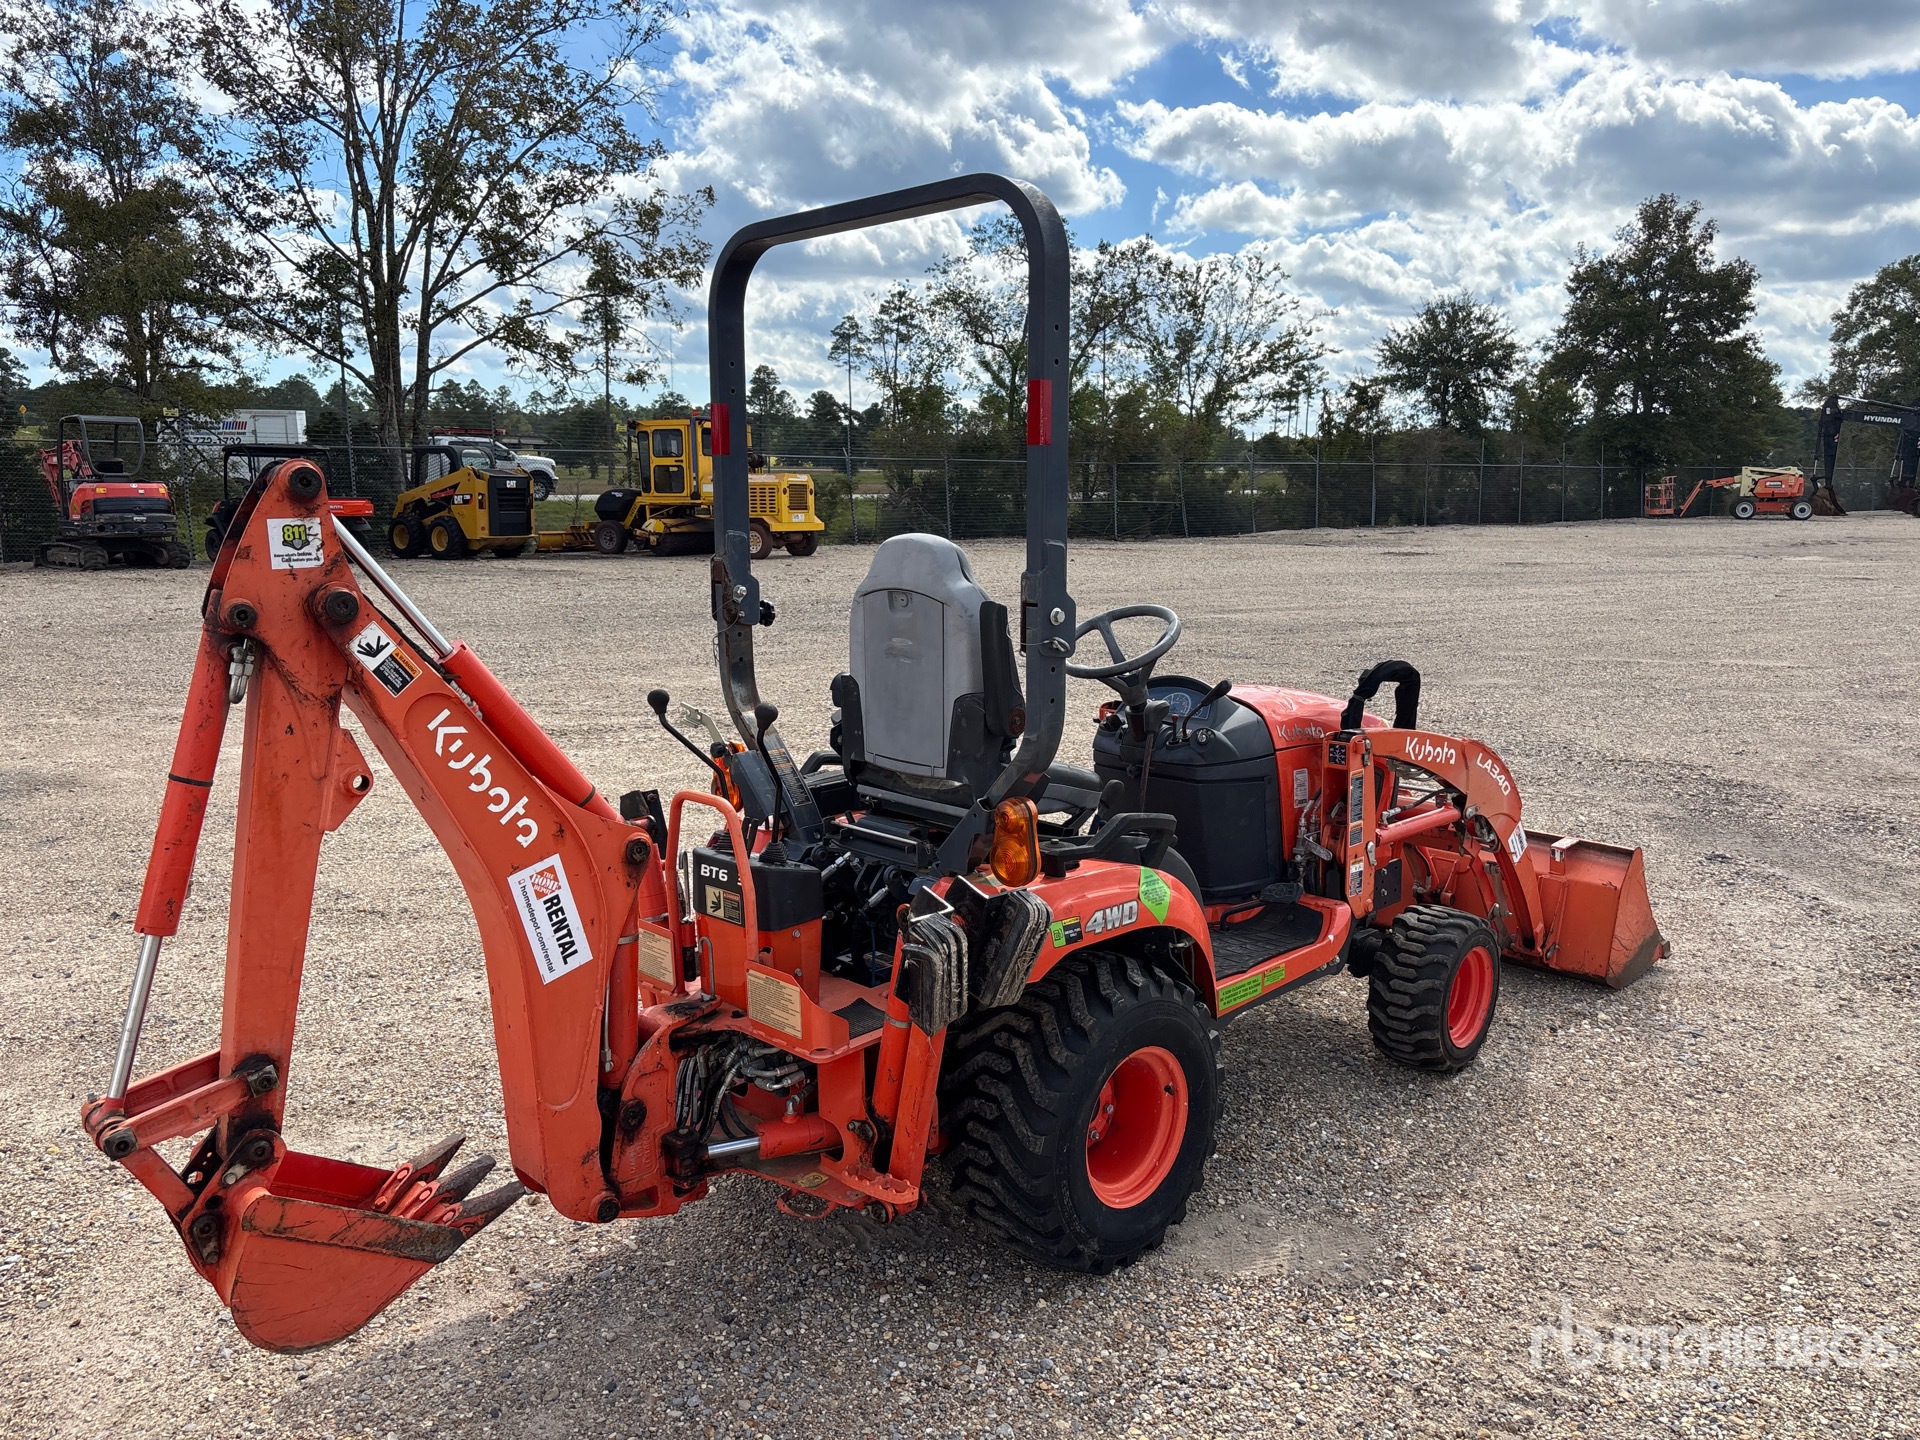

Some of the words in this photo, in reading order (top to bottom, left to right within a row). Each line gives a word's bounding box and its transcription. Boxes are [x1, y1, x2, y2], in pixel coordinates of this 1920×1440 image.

[1864, 415, 1901, 424] HYUNDAI
[506, 480, 516, 488] CAT
[454, 495, 463, 504] CAT
[282, 525, 306, 541] 811
[398, 655, 417, 675] WARNING
[1276, 722, 1324, 740] Kubota
[1405, 736, 1456, 765] Kubota
[427, 708, 538, 848] Kubota
[1476, 753, 1511, 796] LA340
[530, 874, 560, 890] HOME
[542, 872, 554, 880] THE
[700, 864, 728, 882] BT6
[534, 884, 552, 896] DEPOT
[1085, 900, 1138, 935] 4WD
[520, 885, 555, 974] homedepot.com/rental
[543, 894, 578, 965] RENTAL
